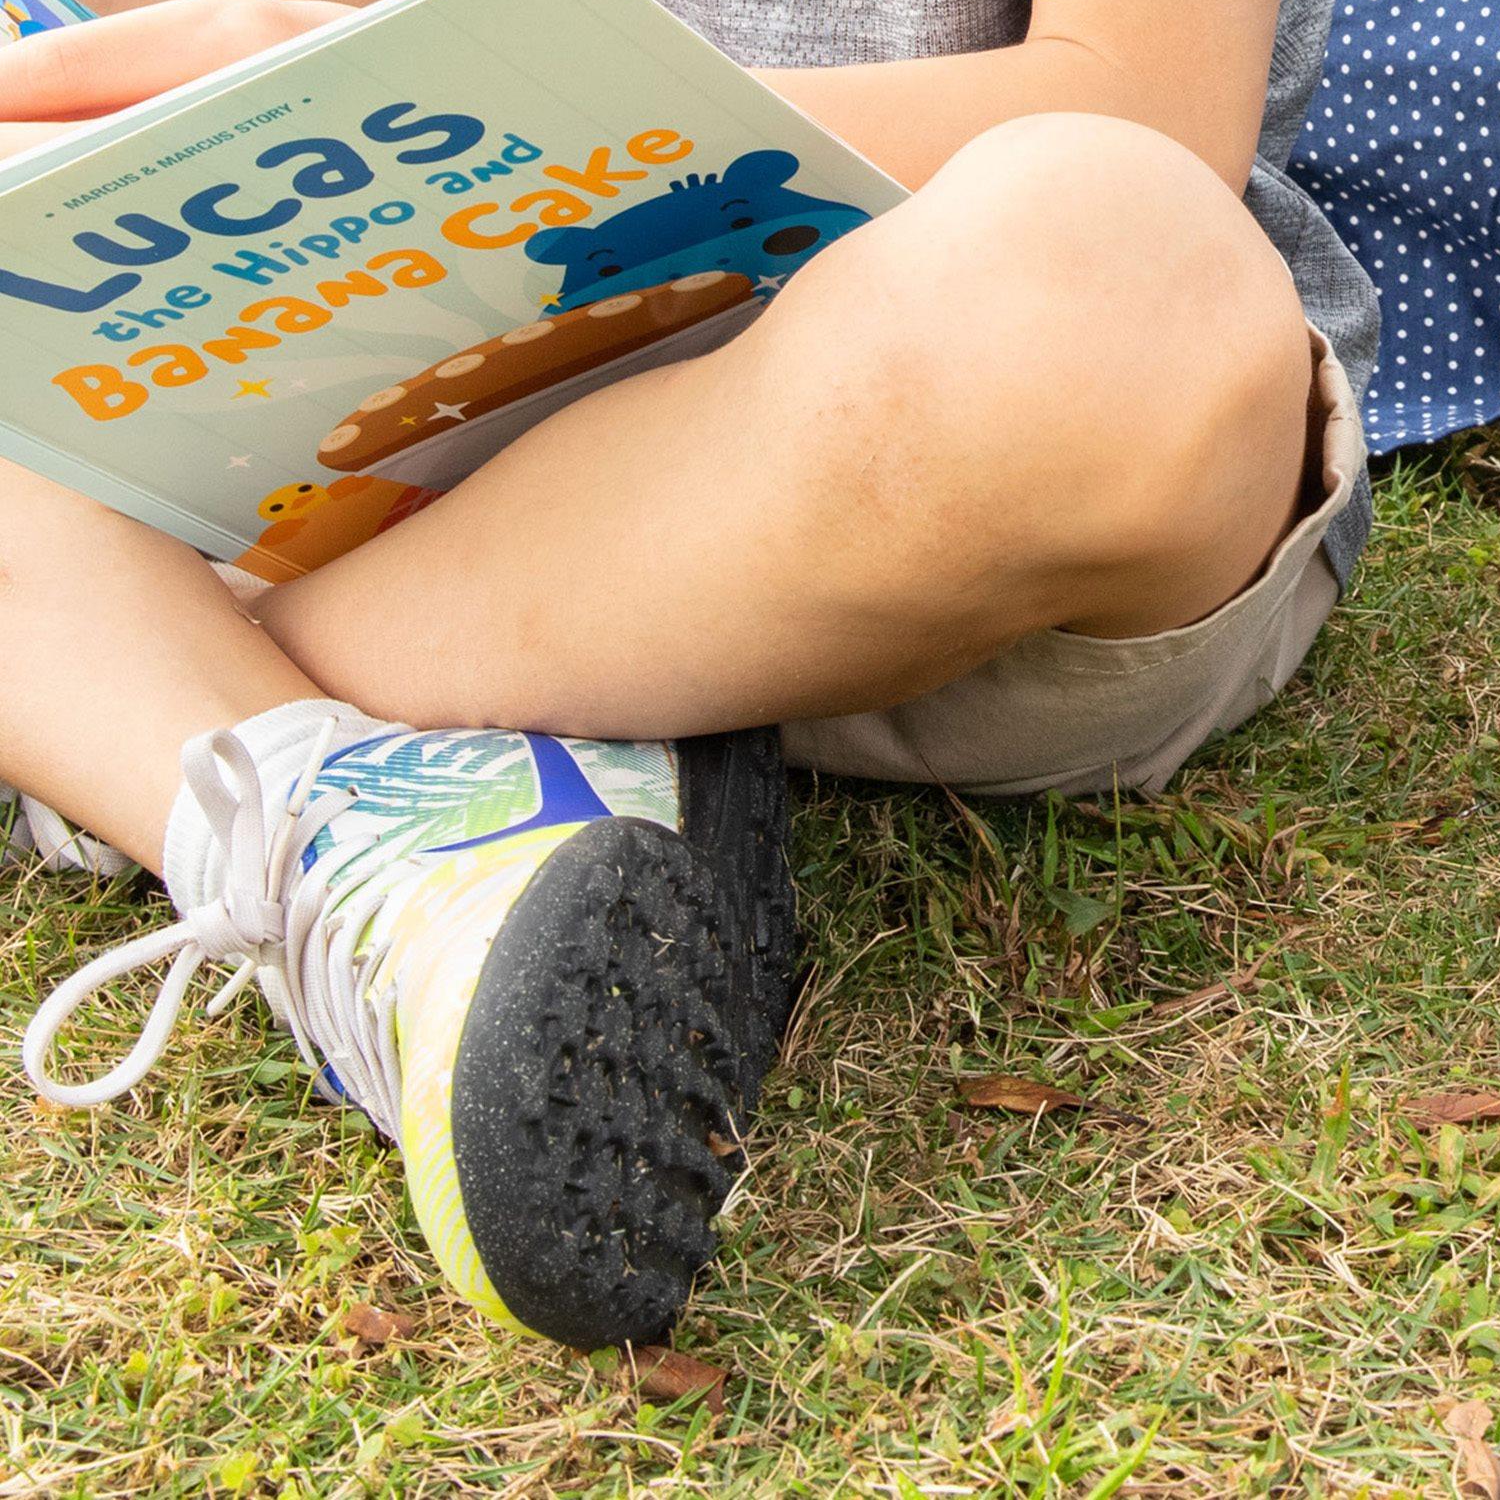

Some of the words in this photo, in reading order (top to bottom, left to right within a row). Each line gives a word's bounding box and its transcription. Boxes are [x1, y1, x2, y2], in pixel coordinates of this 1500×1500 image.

[0, 102, 486, 313] Lucas
[62, 170, 141, 210] MARCUS
[142, 161, 160, 177] &
[160, 130, 235, 171] MARCUS
[237, 102, 294, 135] STORY
[93, 284, 213, 342] the
[211, 200, 416, 285] Hippo
[425, 133, 543, 195] and
[52, 249, 448, 421] Banana
[440, 129, 695, 250] Cake
